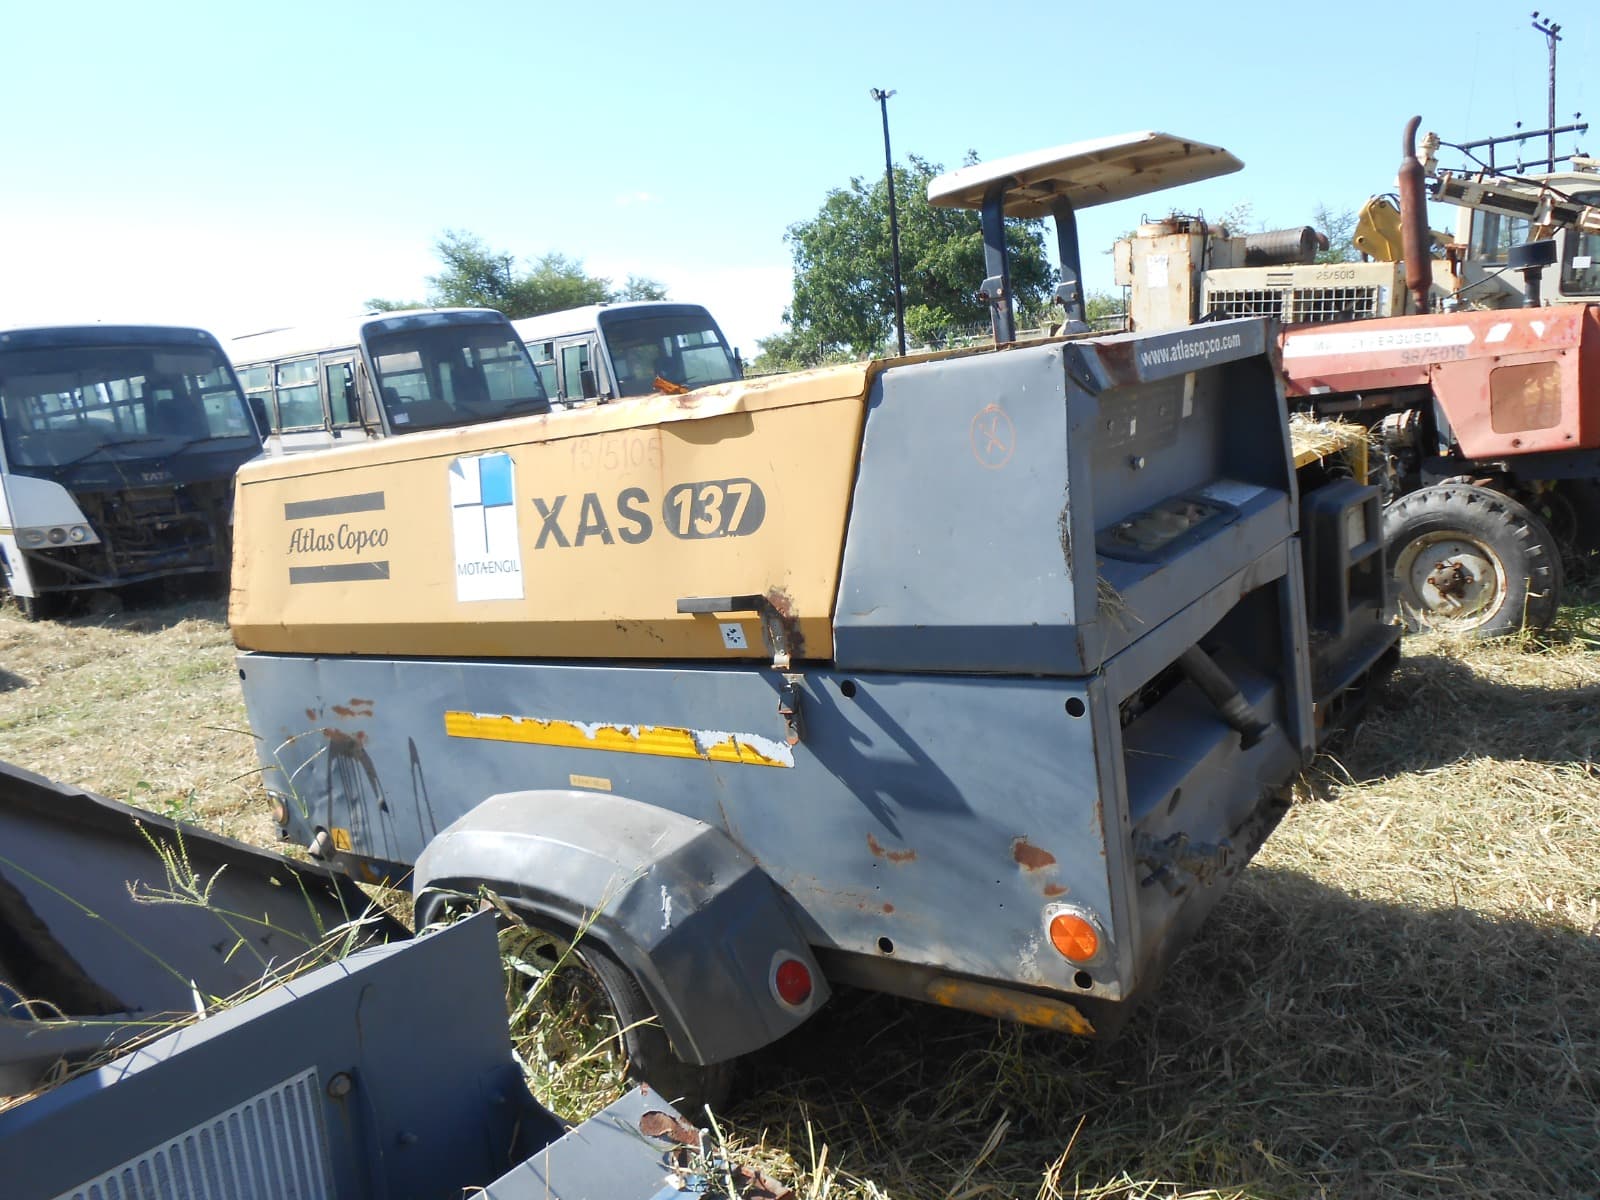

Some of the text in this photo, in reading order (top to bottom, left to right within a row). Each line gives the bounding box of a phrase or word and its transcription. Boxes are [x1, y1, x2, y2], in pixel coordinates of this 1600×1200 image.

[1316, 270, 1356, 280] 25/5013
[1140, 333, 1240, 367] www.atlascopco.com
[1369, 330, 1443, 347] ERGUSON
[532, 483, 752, 549] XAS 137
[287, 524, 389, 555] Atlas Copco
